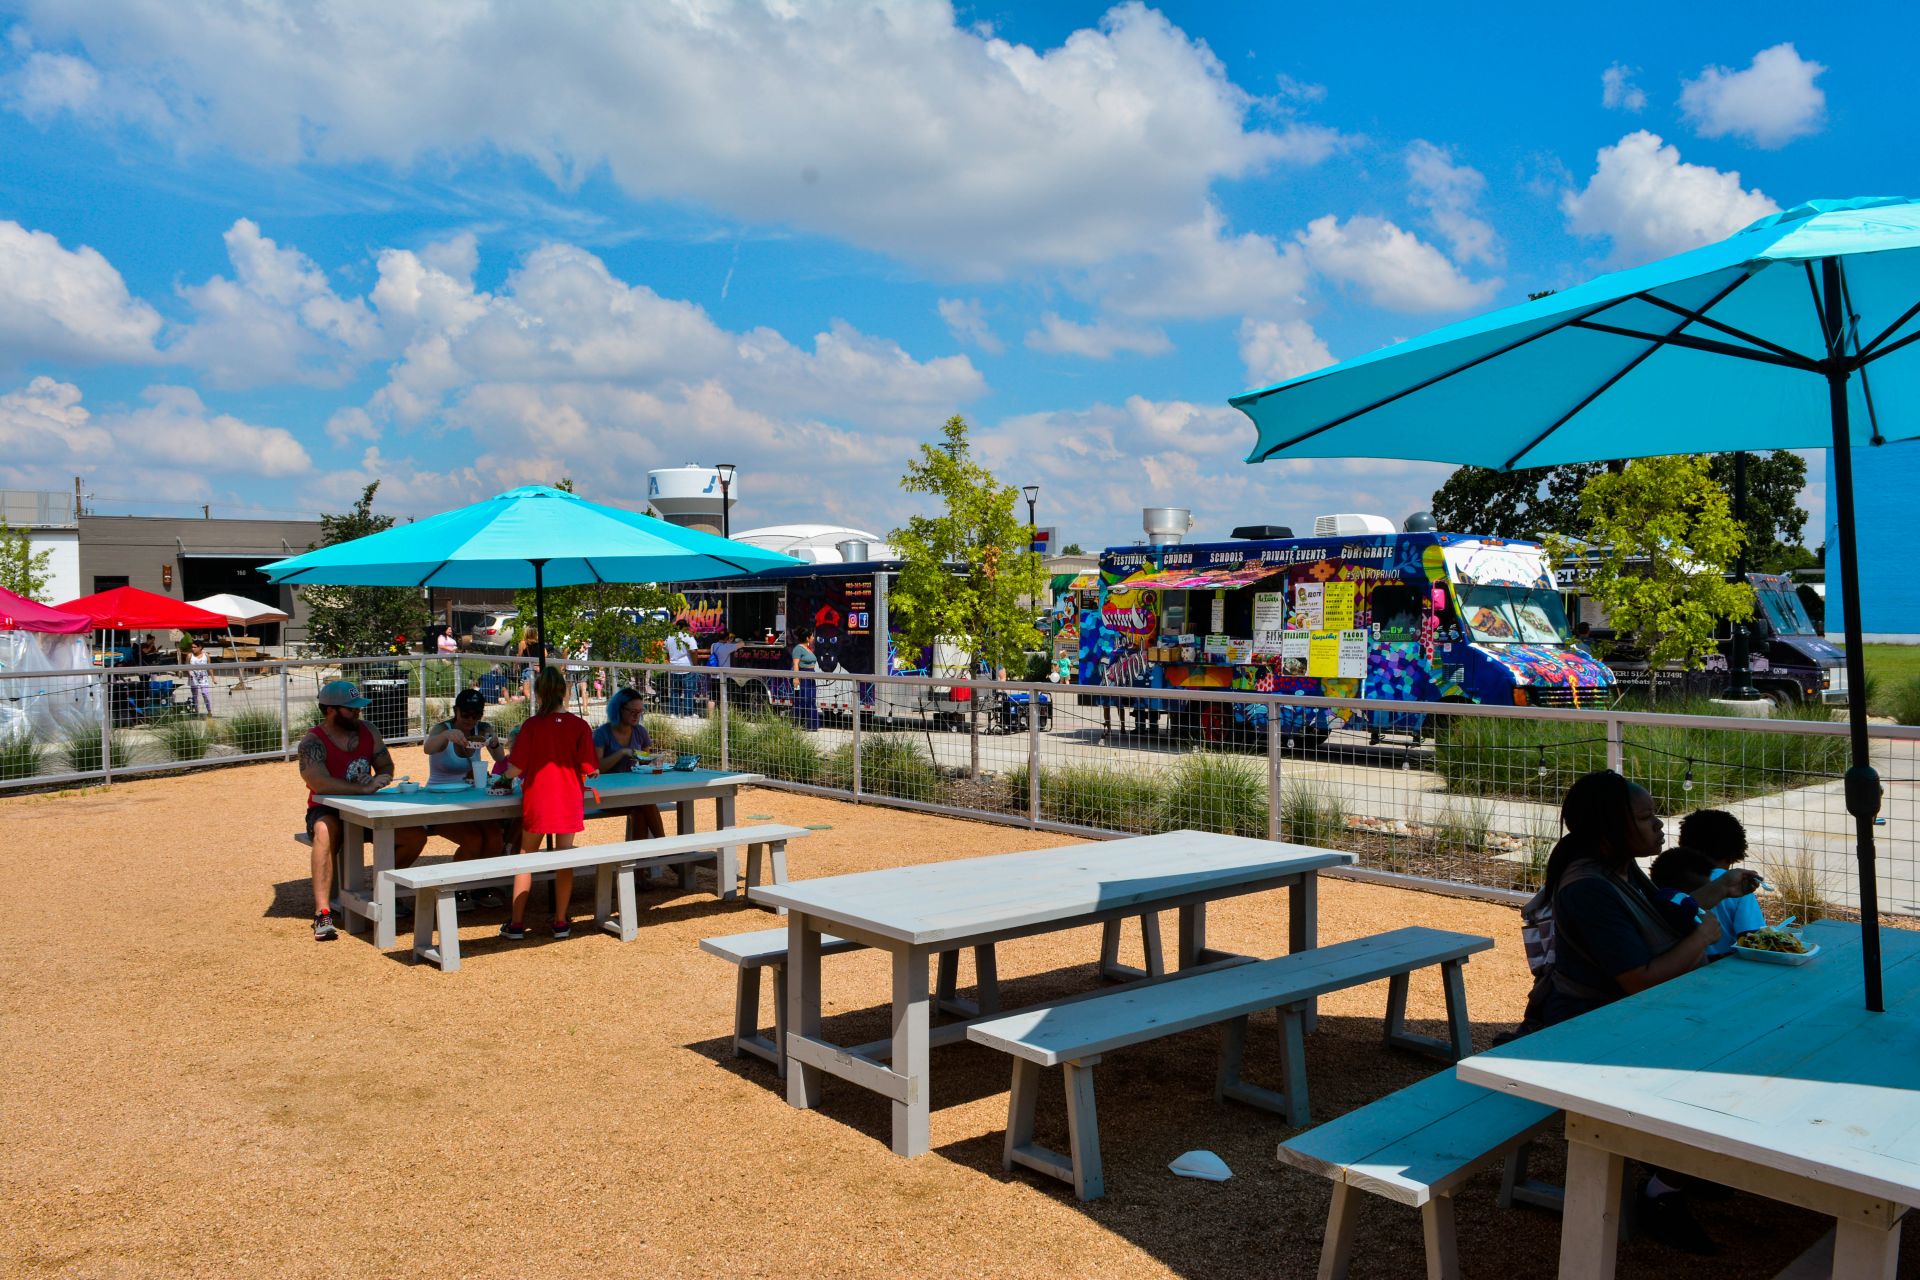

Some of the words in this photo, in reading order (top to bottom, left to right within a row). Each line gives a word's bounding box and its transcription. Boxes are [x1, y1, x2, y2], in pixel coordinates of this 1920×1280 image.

[1113, 554, 1147, 566] FESTIVALS
[1163, 553, 1193, 565] CHURCH
[1209, 551, 1244, 563] SCHOOLS
[1261, 550, 1295, 562] PRIVATE
[1296, 548, 1327, 561] EVENTS
